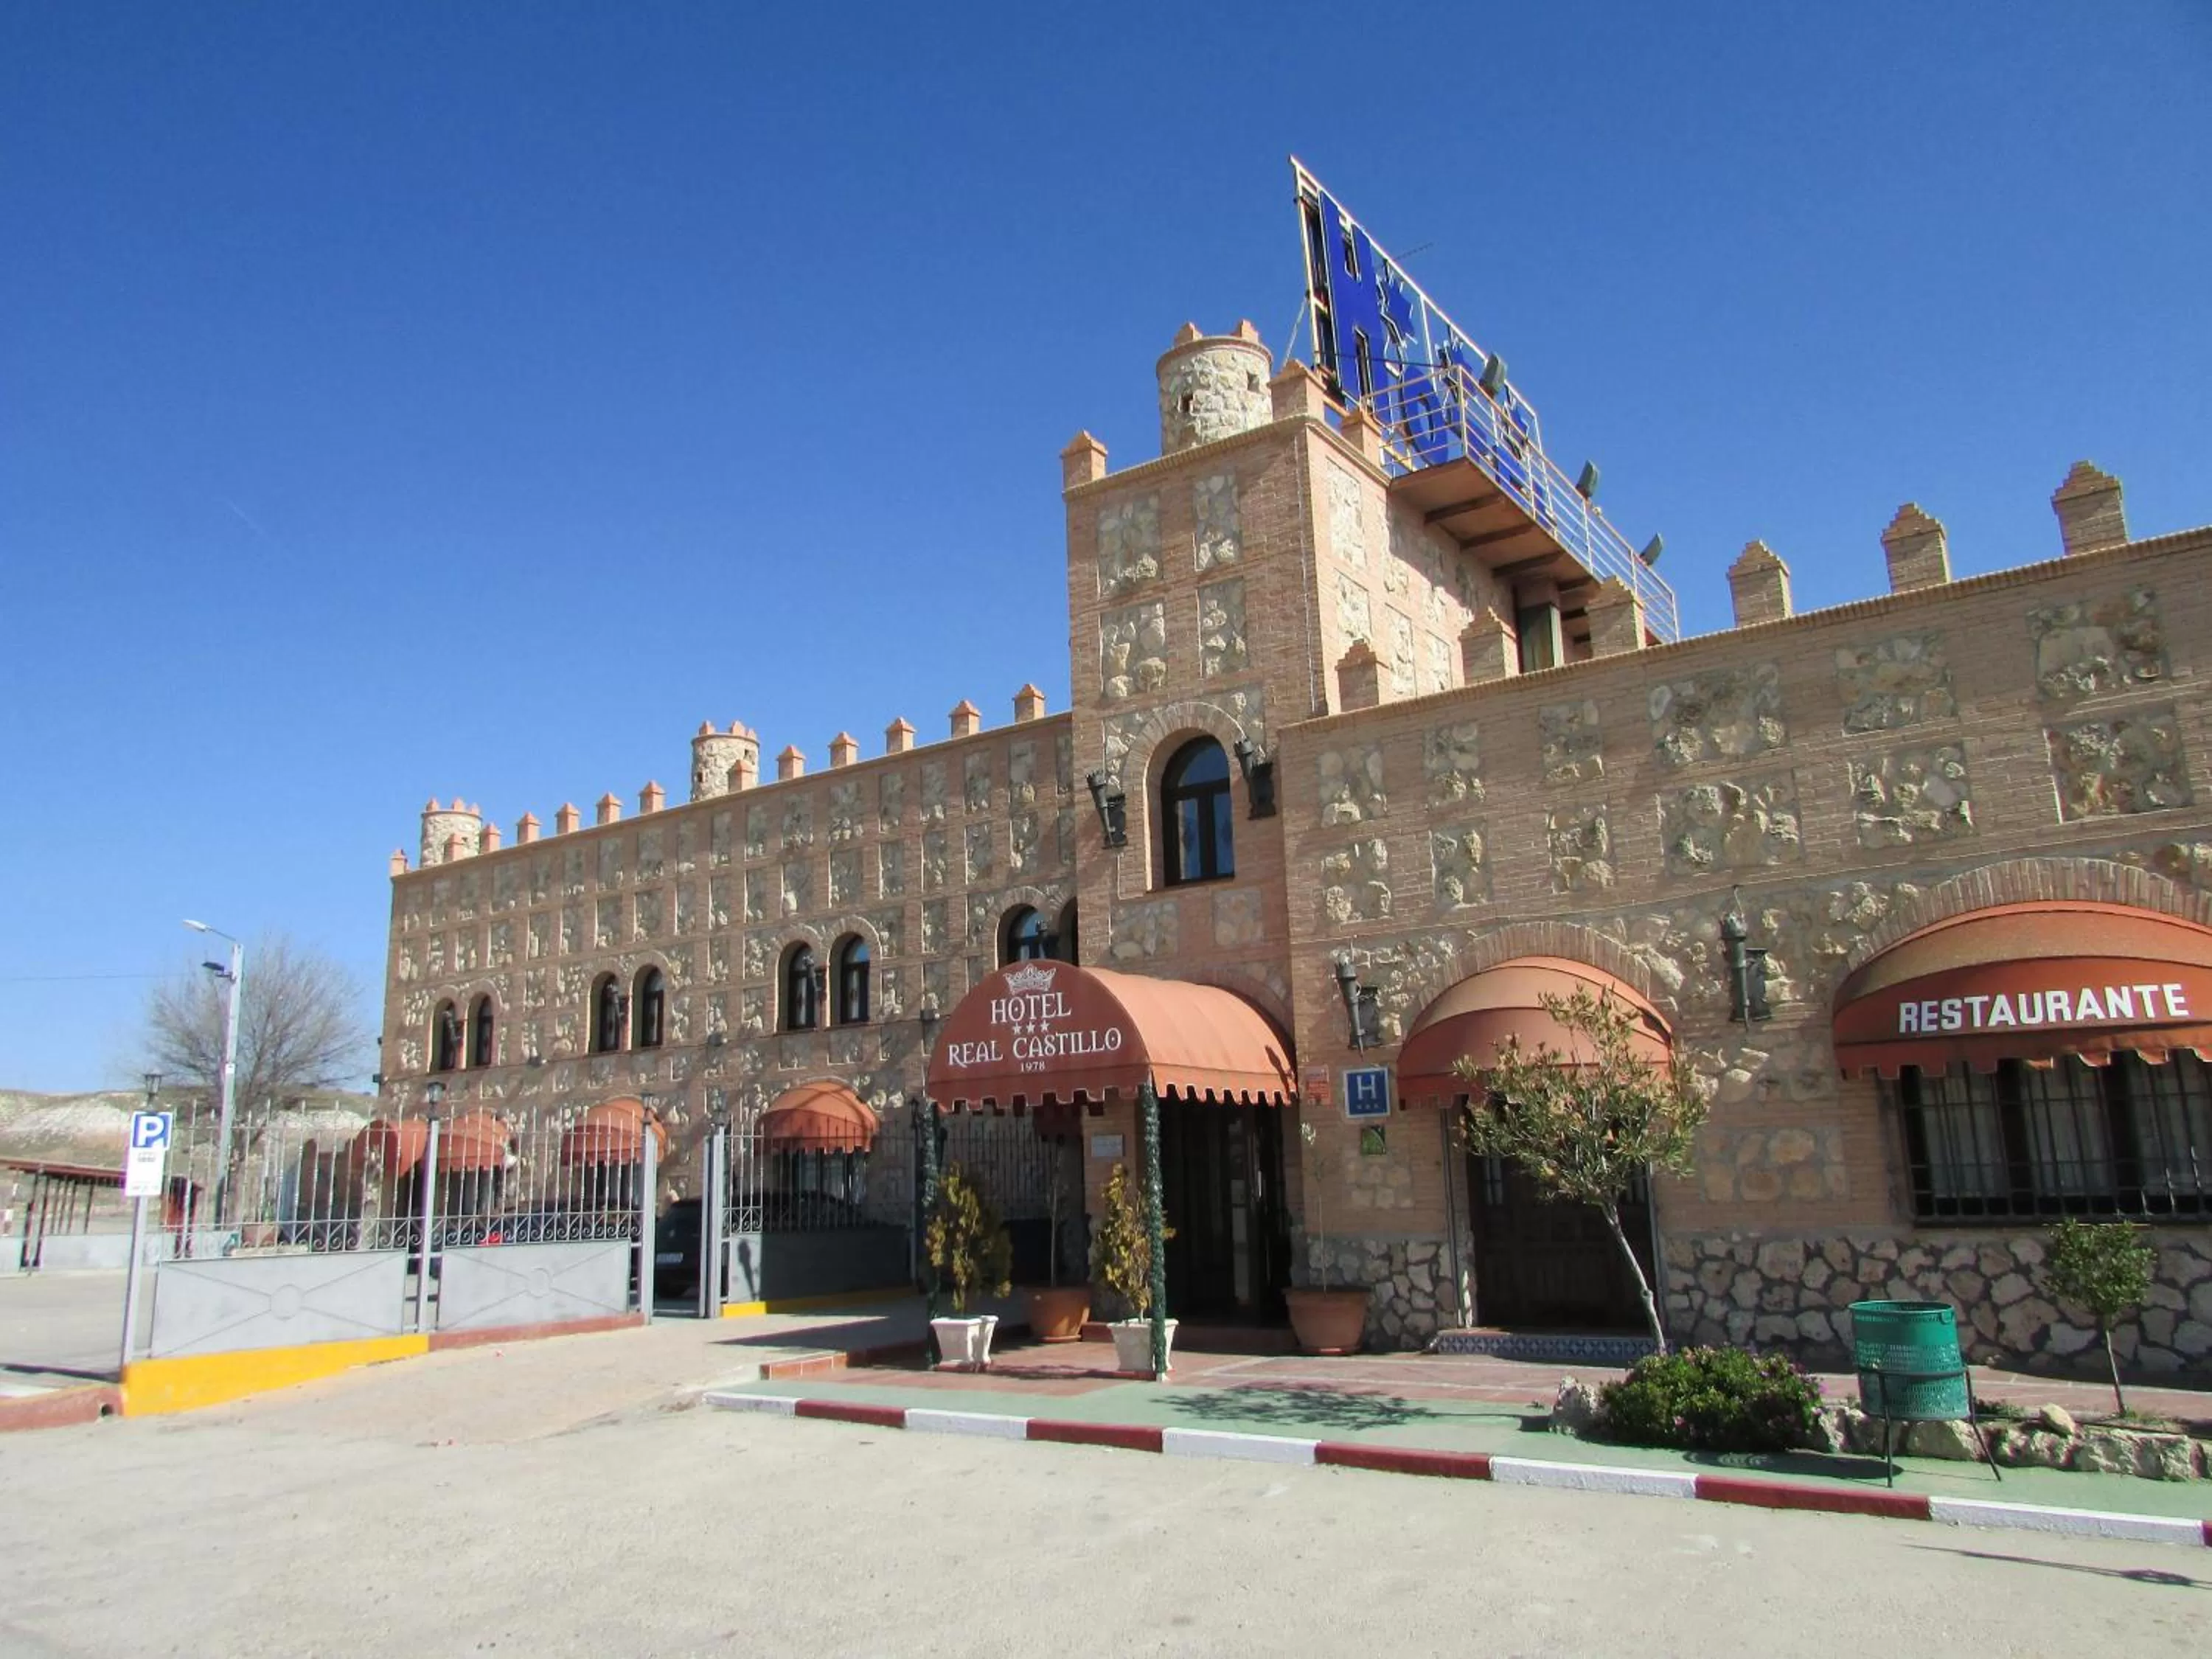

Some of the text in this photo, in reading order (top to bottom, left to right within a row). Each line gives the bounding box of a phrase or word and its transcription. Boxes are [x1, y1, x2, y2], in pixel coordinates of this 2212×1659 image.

[990, 992, 1071, 1024] HOTEL
[1899, 983, 2189, 1033] RESTAURANTE
[947, 1027, 1121, 1068] REAL CASTILLO
[1020, 1061, 1045, 1073] 1978
[1356, 1074, 1377, 1101] H
[136, 1116, 164, 1147] P
